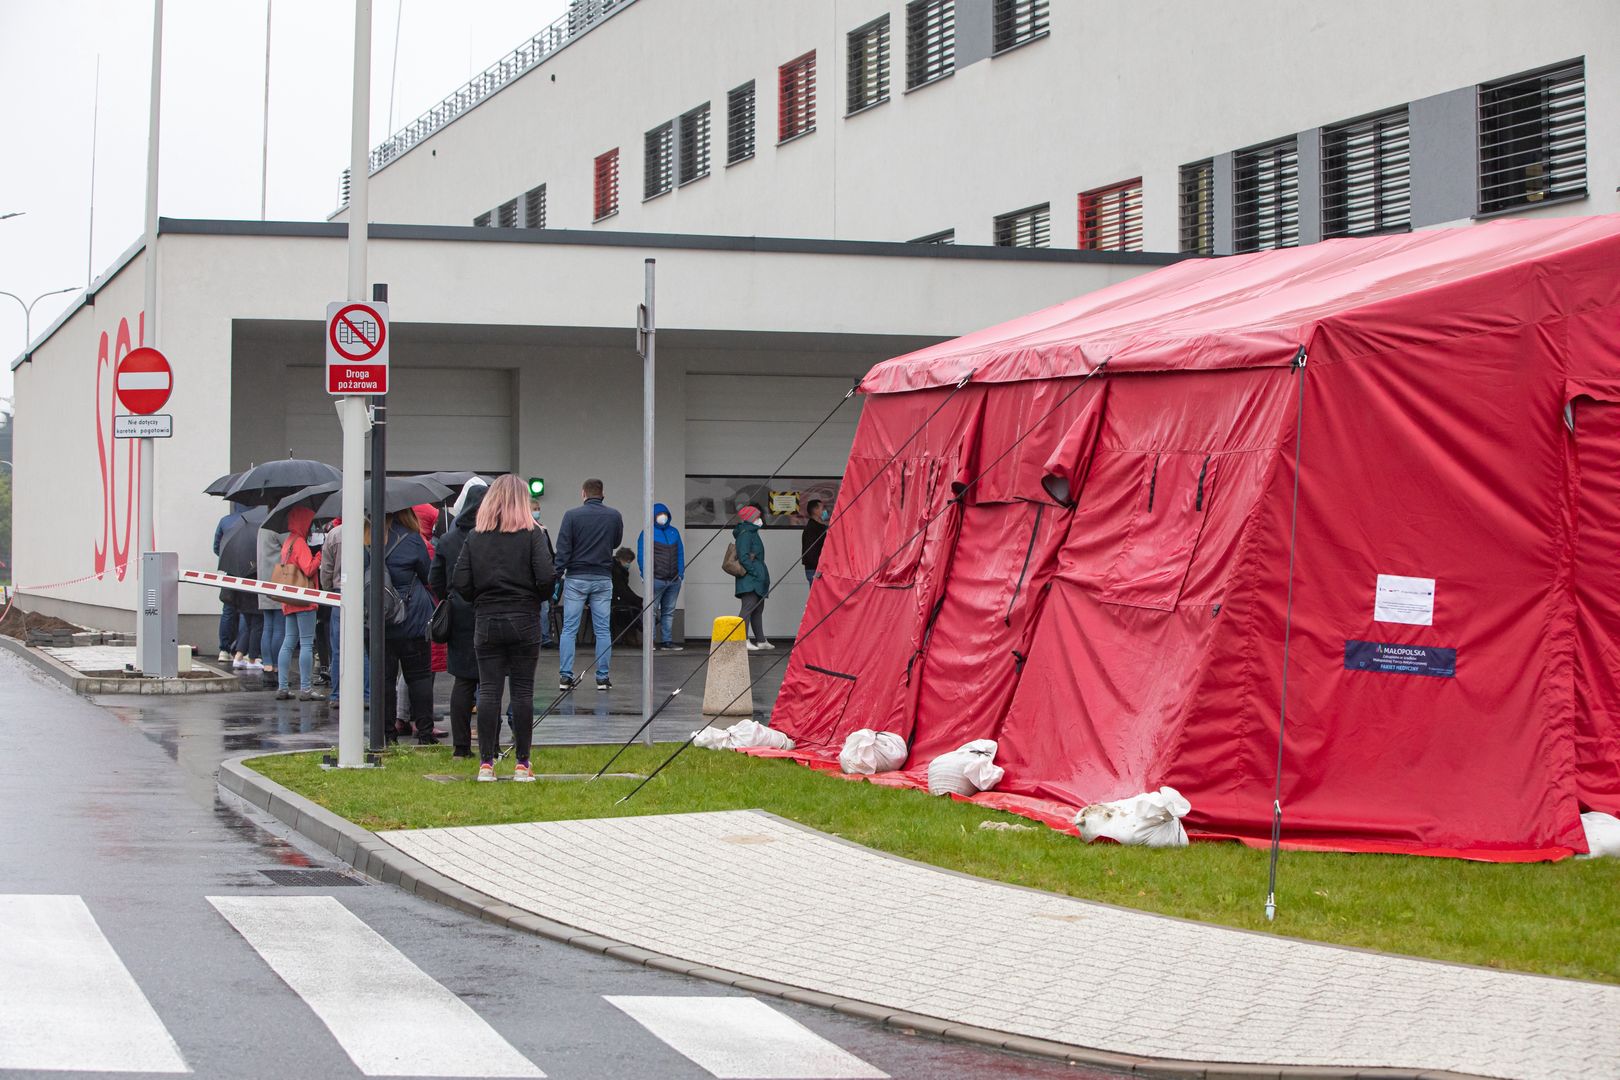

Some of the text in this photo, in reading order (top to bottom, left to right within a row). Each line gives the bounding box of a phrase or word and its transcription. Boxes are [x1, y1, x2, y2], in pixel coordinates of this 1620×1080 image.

[346, 369, 369, 379] Droga
[338, 380, 377, 390] pożarowa
[95, 311, 155, 583] SO
[1383, 647, 1426, 657] MAŁOPOLSKA
